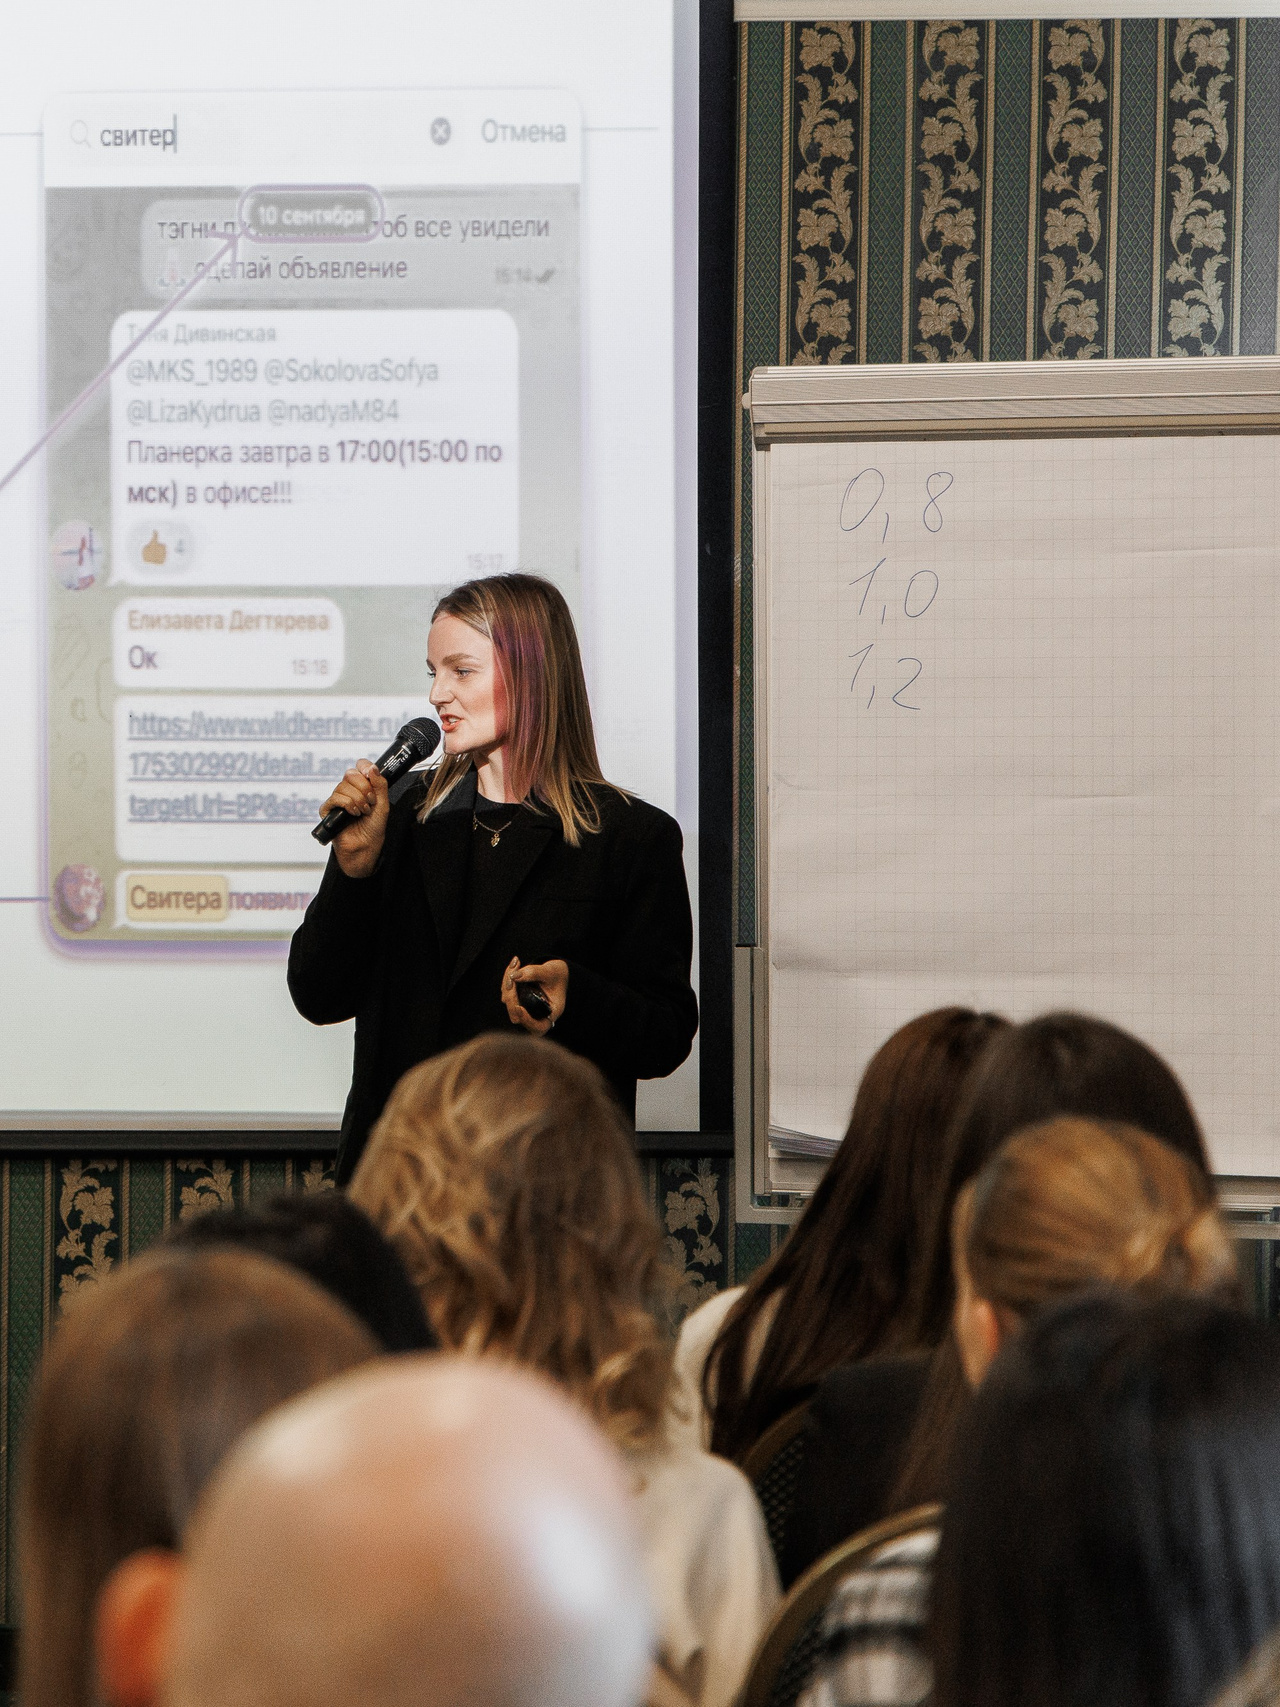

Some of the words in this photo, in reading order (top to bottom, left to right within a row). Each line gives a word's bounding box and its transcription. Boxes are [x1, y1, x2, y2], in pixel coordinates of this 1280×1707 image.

[100, 125, 175, 153] свитер
[482, 119, 567, 145] Отмена
[258, 206, 277, 225] 10
[282, 205, 366, 229] сентября
[414, 219, 453, 238] все
[459, 219, 550, 243] увидели
[279, 255, 408, 280] объявление
[174, 323, 277, 345] Дивинская
[127, 358, 258, 387] @MKS_1989
[264, 357, 439, 386] @SokolovaSofya
[269, 397, 400, 427] @nadyaM84
[127, 440, 233, 468] Планерка
[239, 443, 312, 468] завтра
[319, 445, 330, 463] в
[337, 439, 468, 468] 17:00(15:00
[475, 442, 503, 462] по
[127, 481, 178, 508] мск)
[186, 485, 197, 503] в
[204, 481, 292, 508] офисе!!!
[128, 610, 224, 632] Елизавета
[228, 610, 329, 635] Дегтярева
[128, 645, 159, 671] Ок
[130, 884, 221, 914] Свитера
